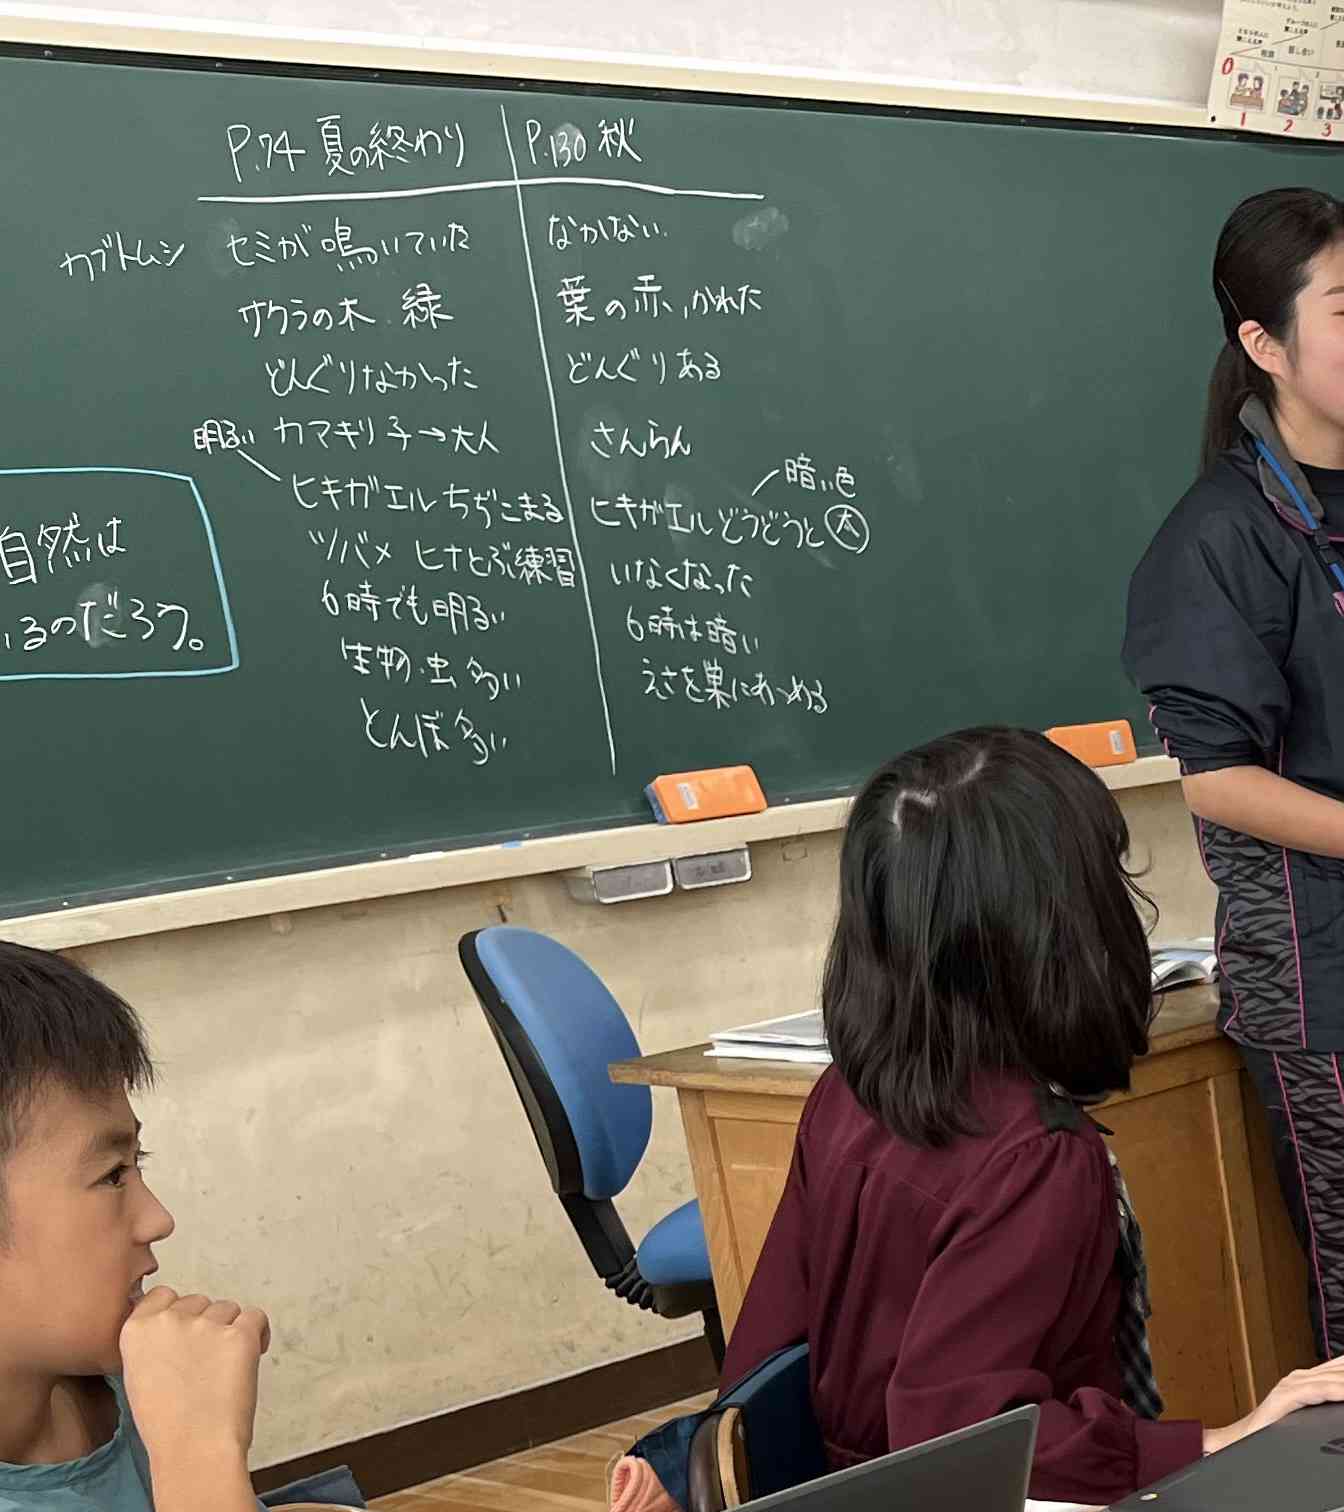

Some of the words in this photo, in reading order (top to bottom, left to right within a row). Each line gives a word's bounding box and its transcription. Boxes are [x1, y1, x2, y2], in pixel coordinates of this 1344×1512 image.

[317, 115, 464, 177] 夏の終わり
[598, 117, 643, 163] 秋
[60, 230, 186, 281] カブトムシ
[265, 353, 479, 397] どんぐりなかった
[193, 418, 255, 455] 明るい
[590, 419, 692, 459] さんらん
[0, 512, 127, 585] 自然は
[308, 528, 392, 569] ツバメ
[609, 558, 754, 599] いなくなった
